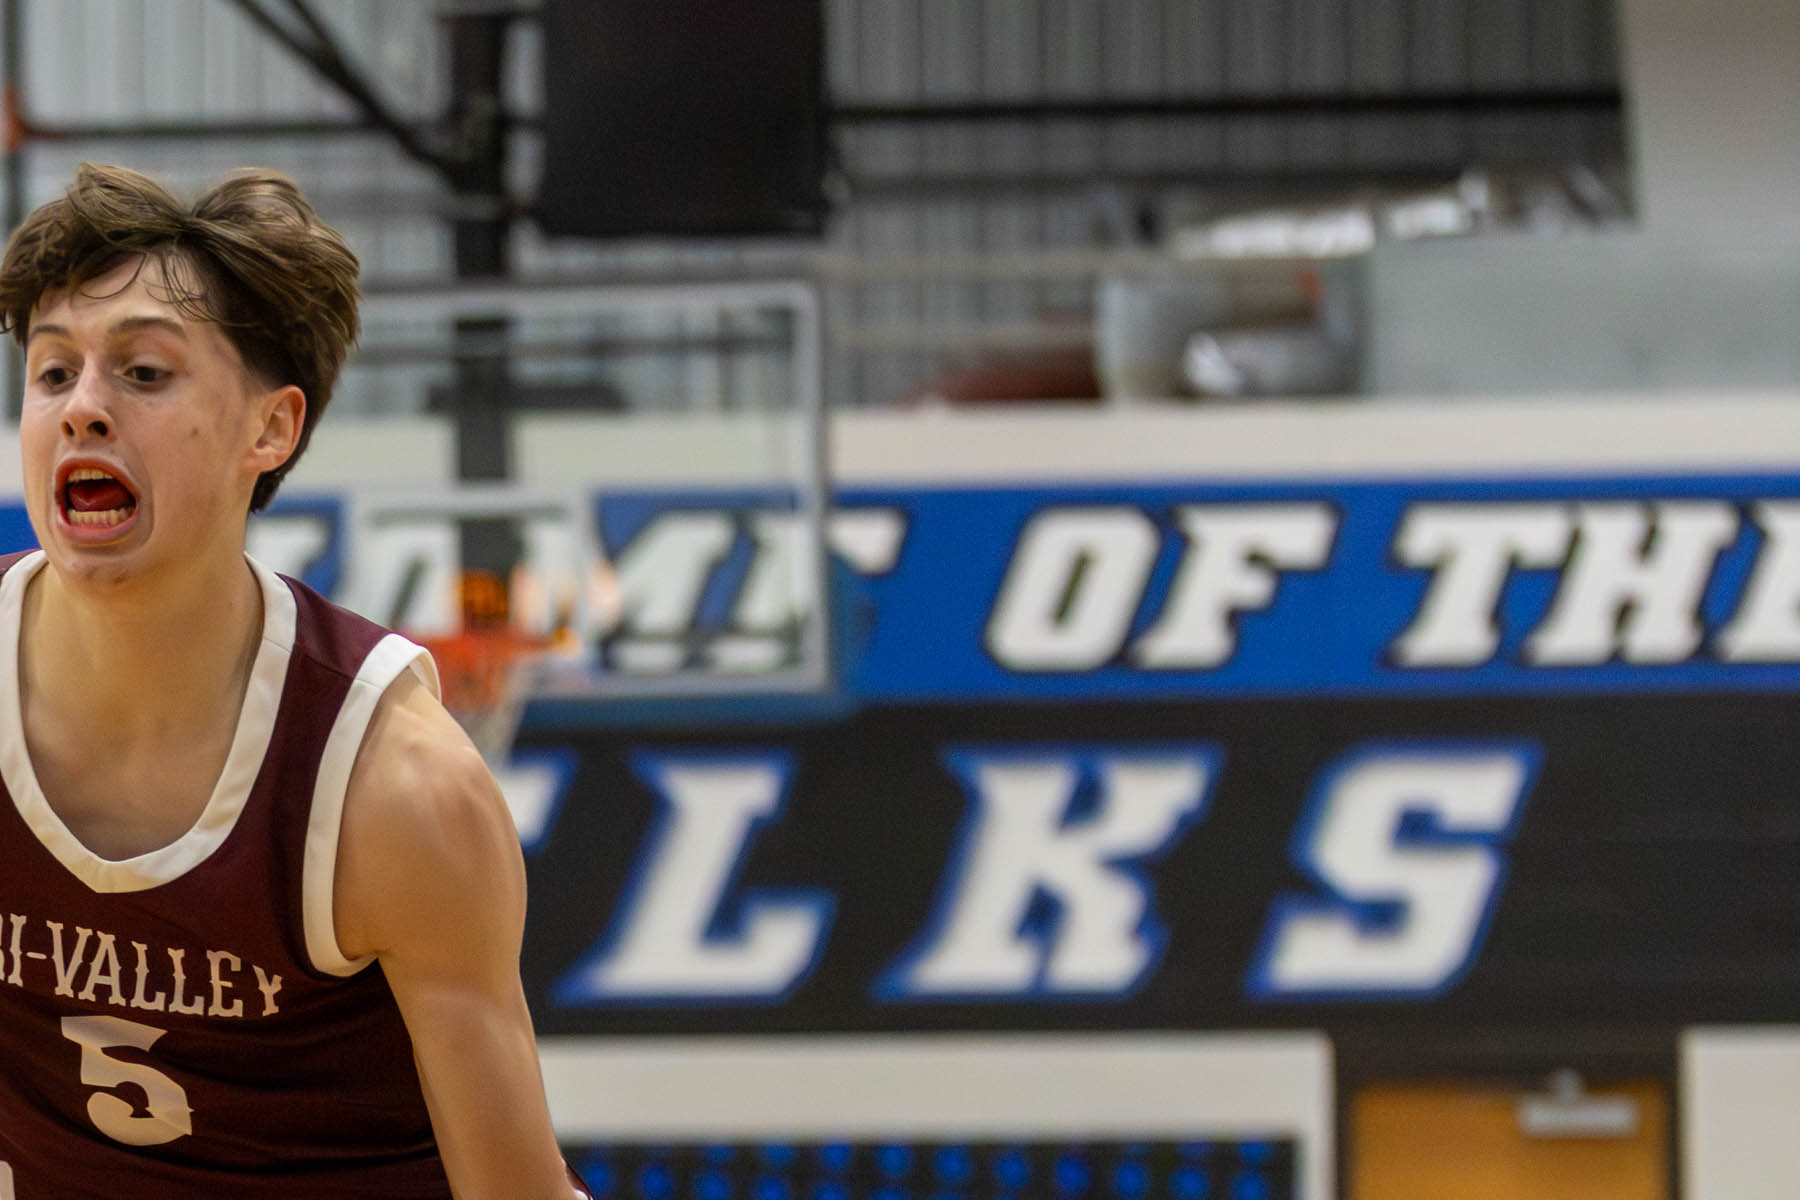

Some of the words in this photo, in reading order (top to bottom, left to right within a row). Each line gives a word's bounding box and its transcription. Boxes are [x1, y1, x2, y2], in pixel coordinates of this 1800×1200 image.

[984, 504, 1340, 671] OF
[502, 746, 1542, 999] LKS
[60, 1014, 195, 1147] 5
